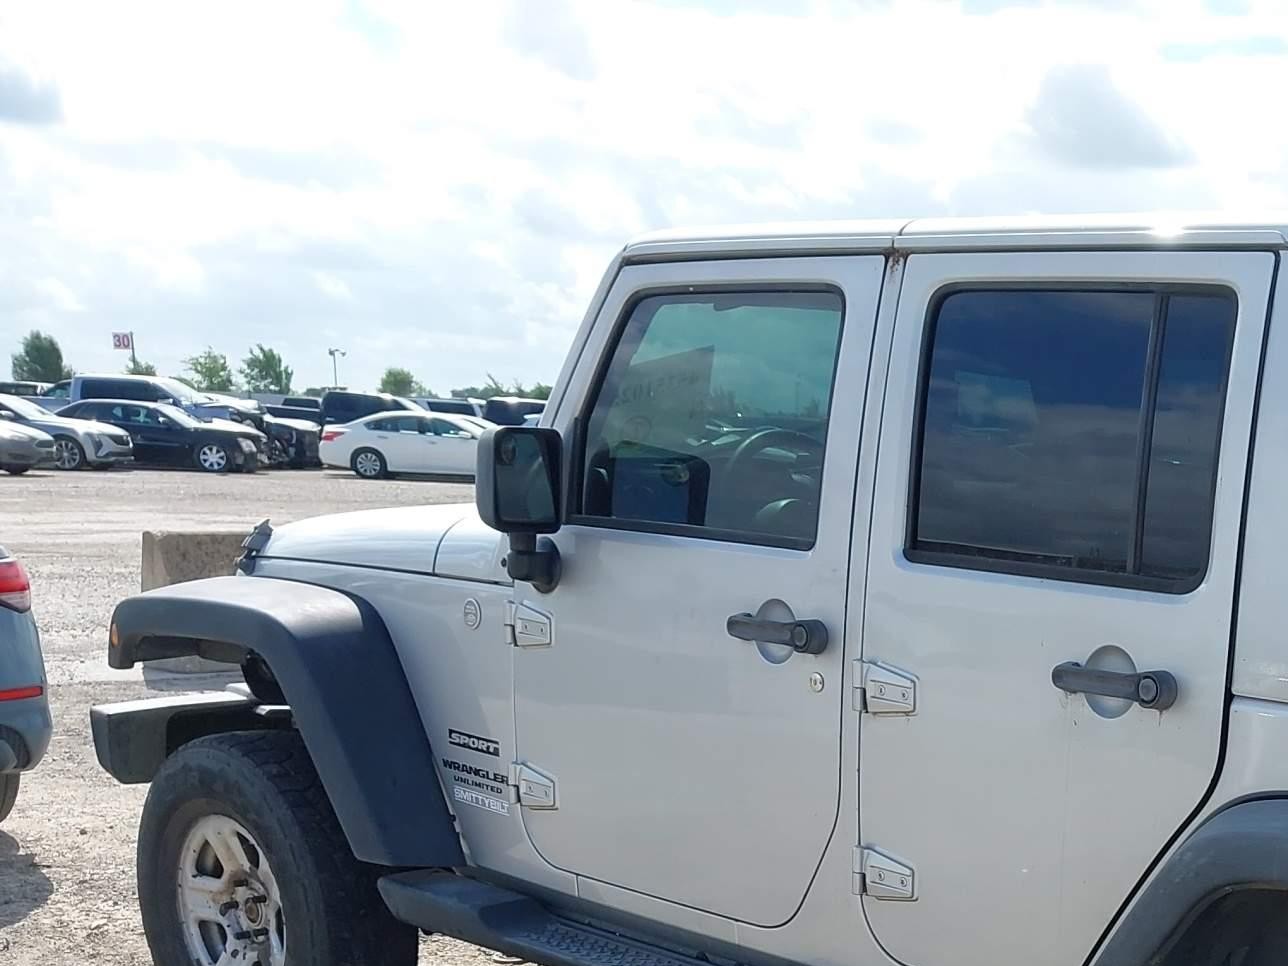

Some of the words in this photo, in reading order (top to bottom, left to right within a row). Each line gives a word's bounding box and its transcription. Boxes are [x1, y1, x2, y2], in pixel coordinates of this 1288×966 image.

[113, 334, 130, 348] 30
[450, 732, 500, 753] SPORT
[442, 758, 508, 786] WRANGLER
[453, 775, 503, 794] UNLIMITED
[453, 786, 509, 815] SMITTYBILT
